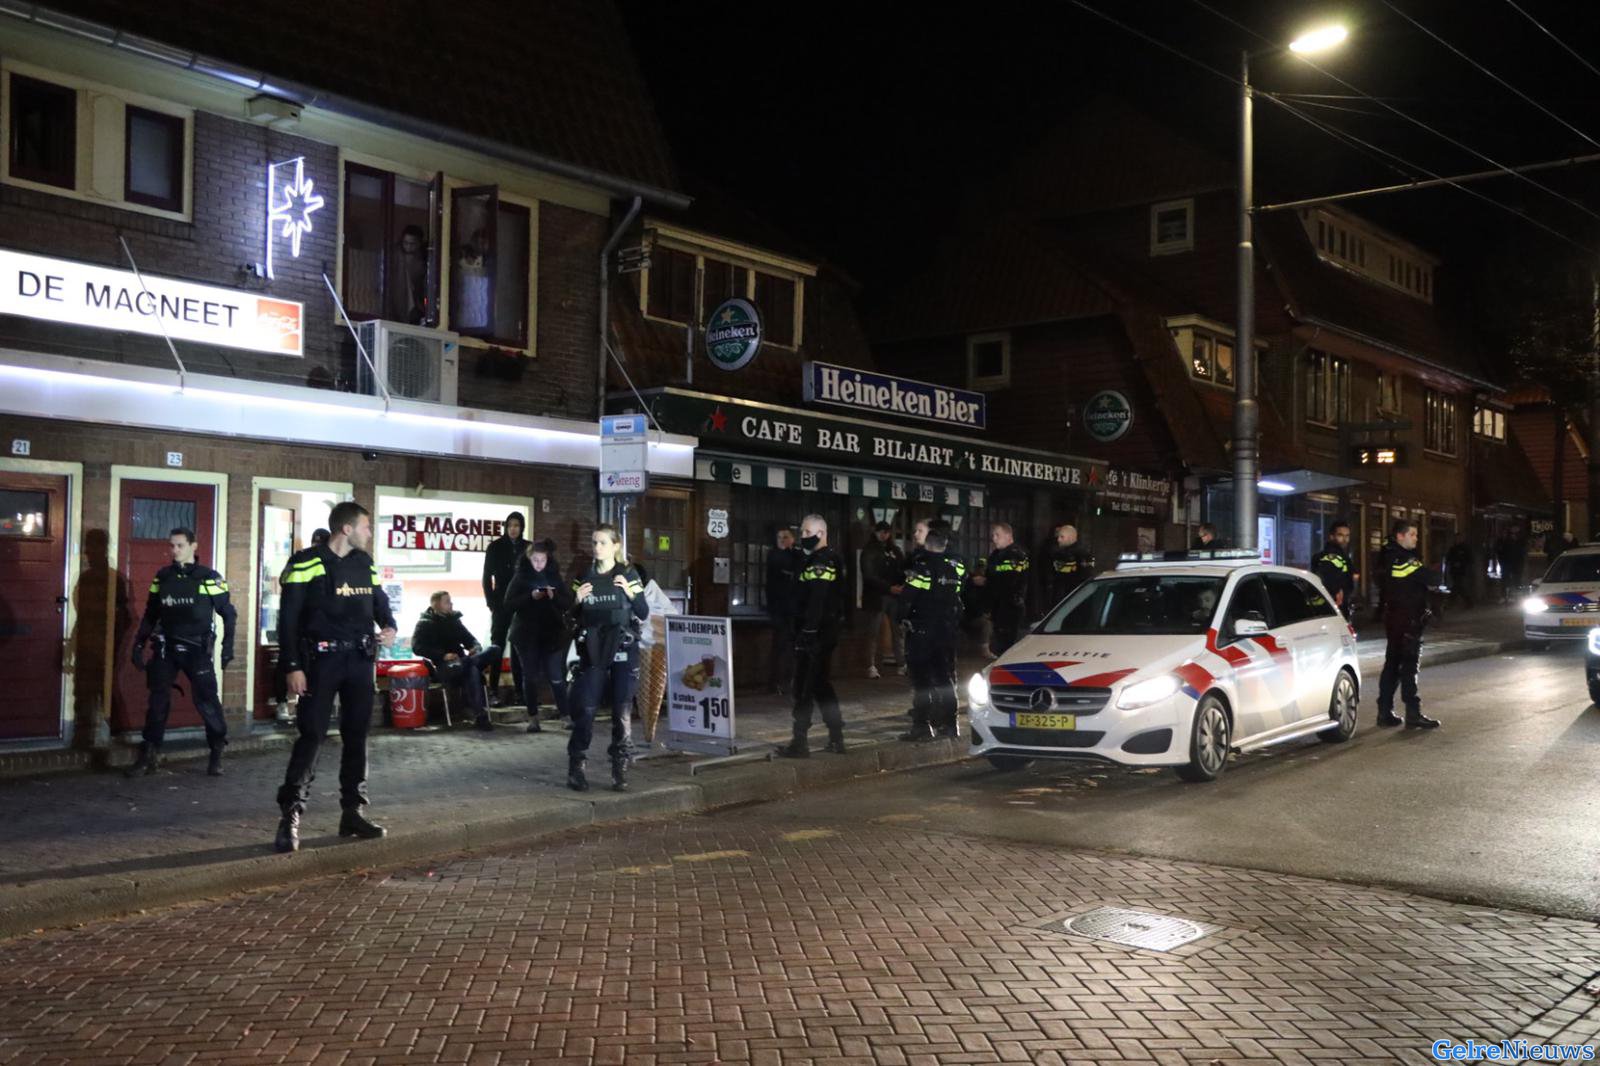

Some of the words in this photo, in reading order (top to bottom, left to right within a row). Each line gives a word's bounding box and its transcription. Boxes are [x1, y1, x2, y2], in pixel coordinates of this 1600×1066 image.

[18, 270, 64, 302] DE
[85, 281, 239, 328] MAGNEET
[820, 368, 932, 417] Heineken
[934, 389, 979, 424] Bier
[16, 442, 26, 453] 21
[741, 416, 802, 445] CAFE
[817, 428, 860, 453] BAR
[873, 437, 953, 467] BILJART
[981, 454, 1081, 485] KLINKERTJE
[170, 454, 181, 464] 23
[393, 514, 417, 533] DE
[1037, 651, 1112, 659] POLITIE
[1019, 715, 1068, 728] ZF-325-P
